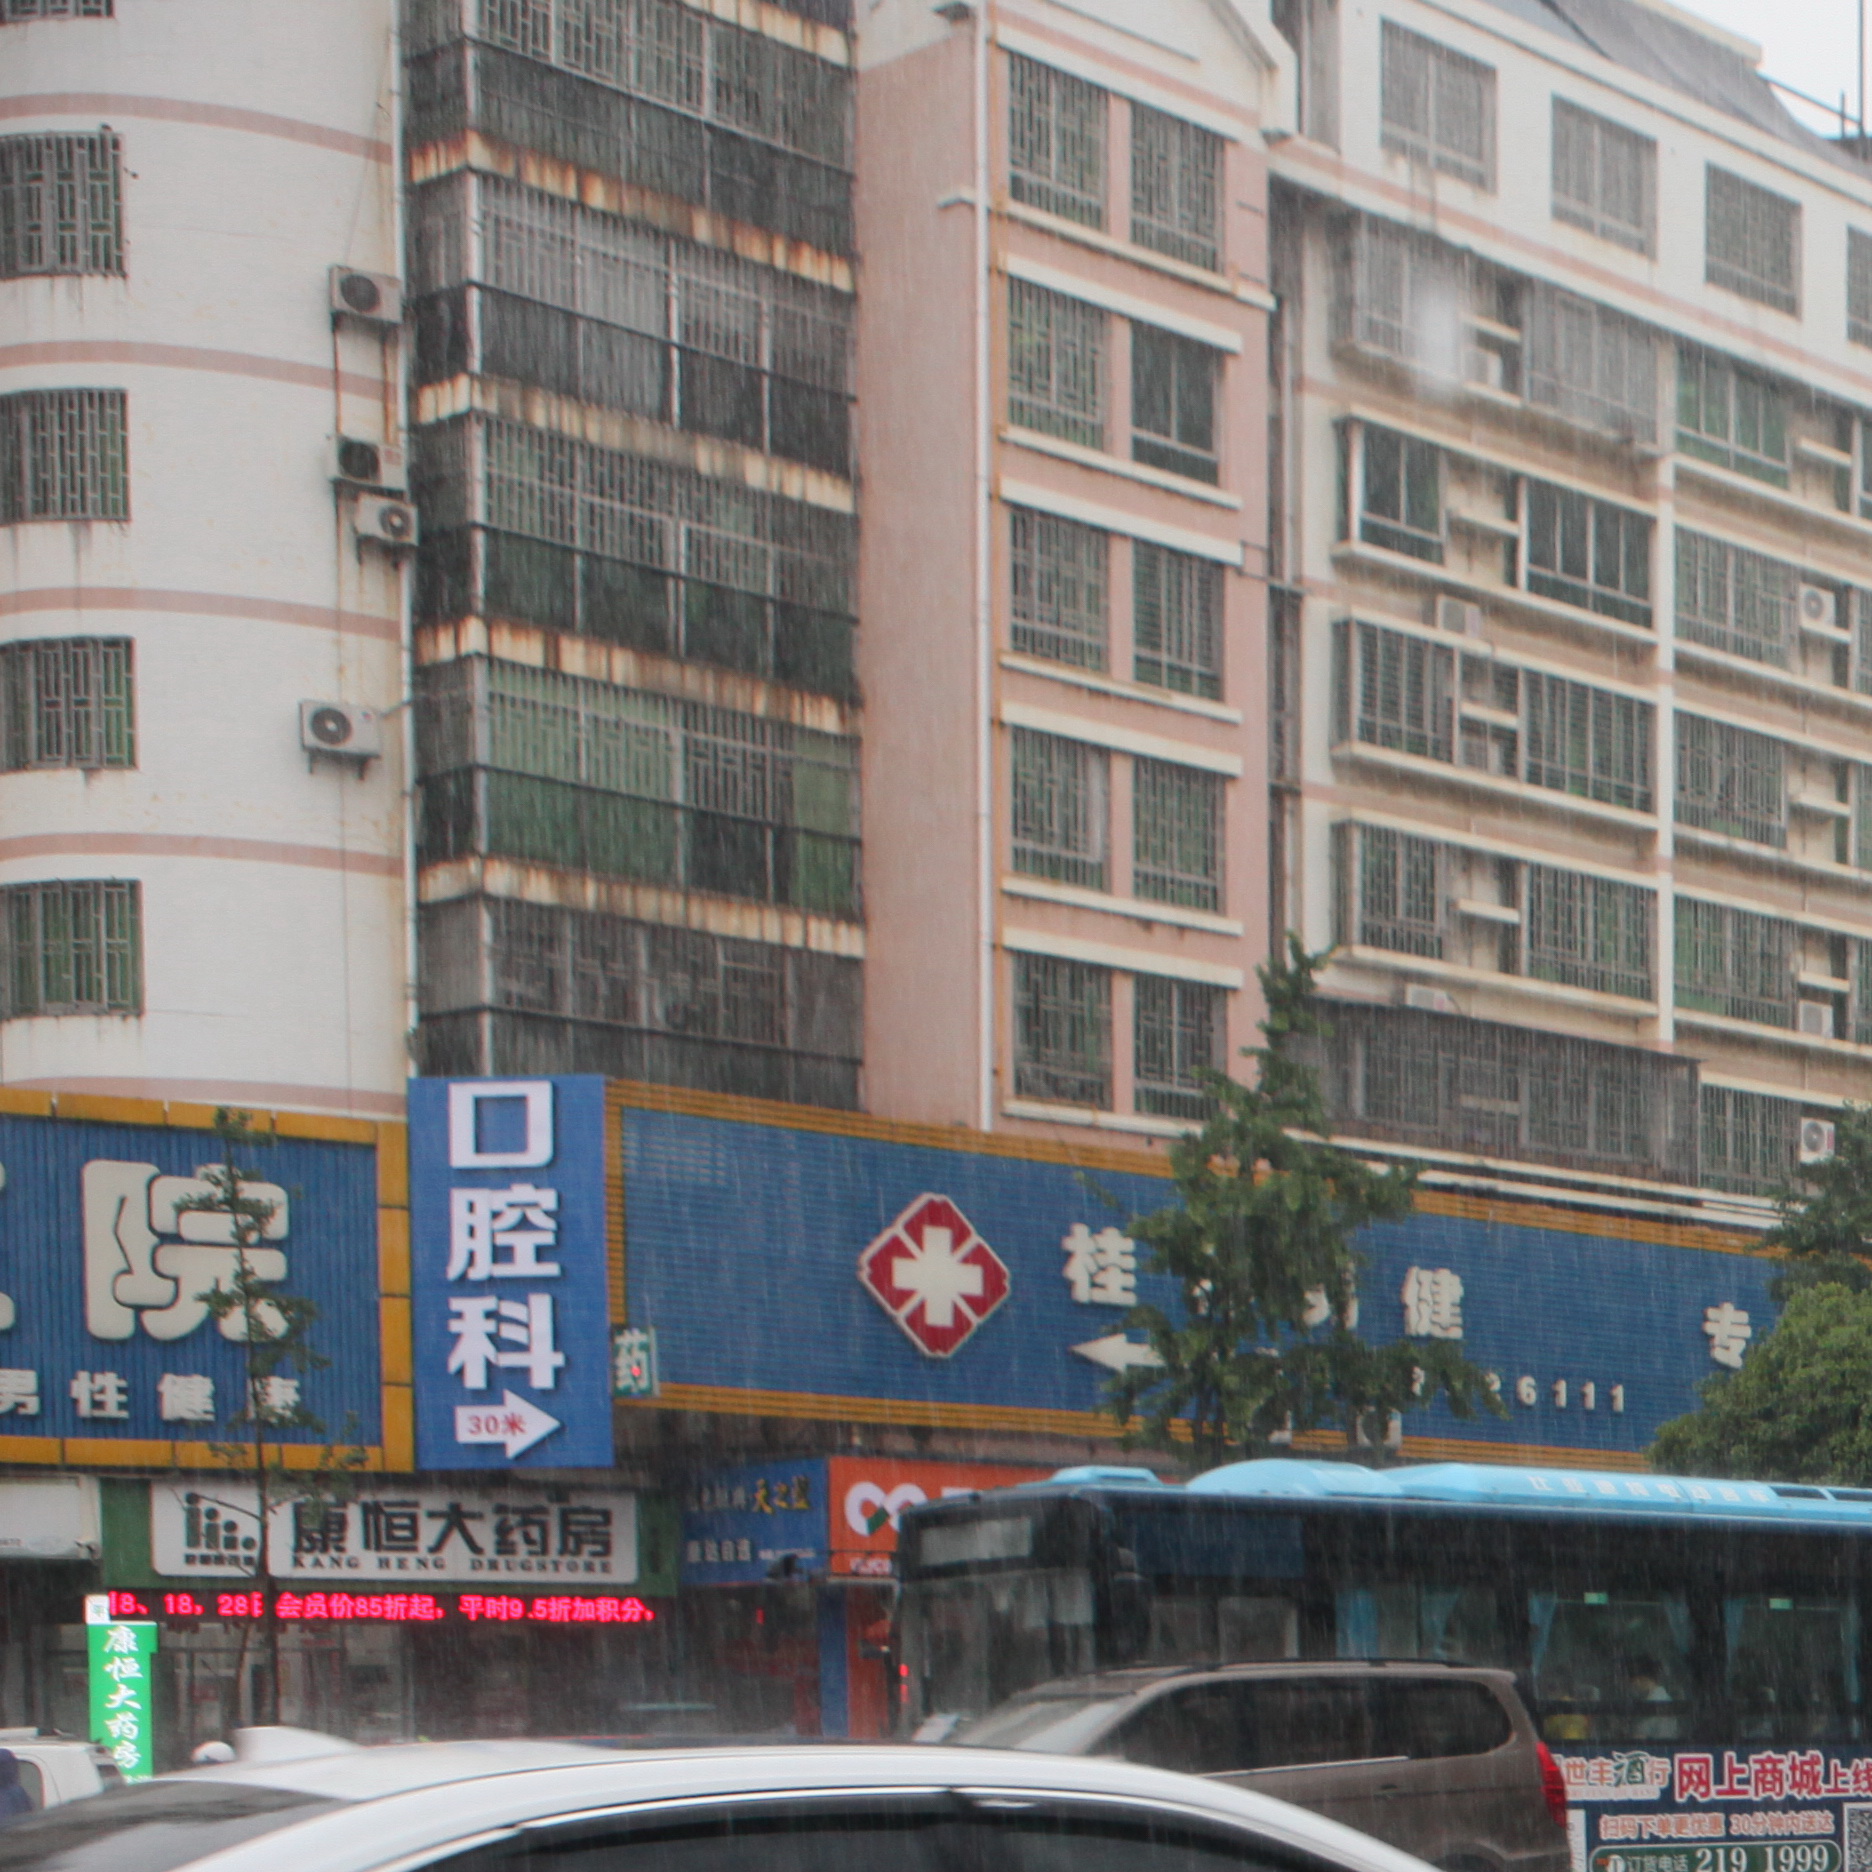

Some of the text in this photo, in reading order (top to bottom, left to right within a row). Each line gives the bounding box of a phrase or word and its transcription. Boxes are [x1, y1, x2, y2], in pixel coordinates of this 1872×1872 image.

[446, 1079, 566, 1390] 口腔科
[614, 1328, 649, 1395] 药
[467, 1413, 527, 1437] 30米
[293, 1499, 613, 1557] 康恒大药房
[293, 1555, 613, 1574] KANG HENG DRUGSTORE
[103, 1625, 143, 1769] 康恒大药房
[1676, 1752, 1823, 1800] 网上商城
[1600, 1810, 1835, 1840] 扫码下单更优惠 30分钟内送达
[1766, 1844, 1829, 1872] 1999
